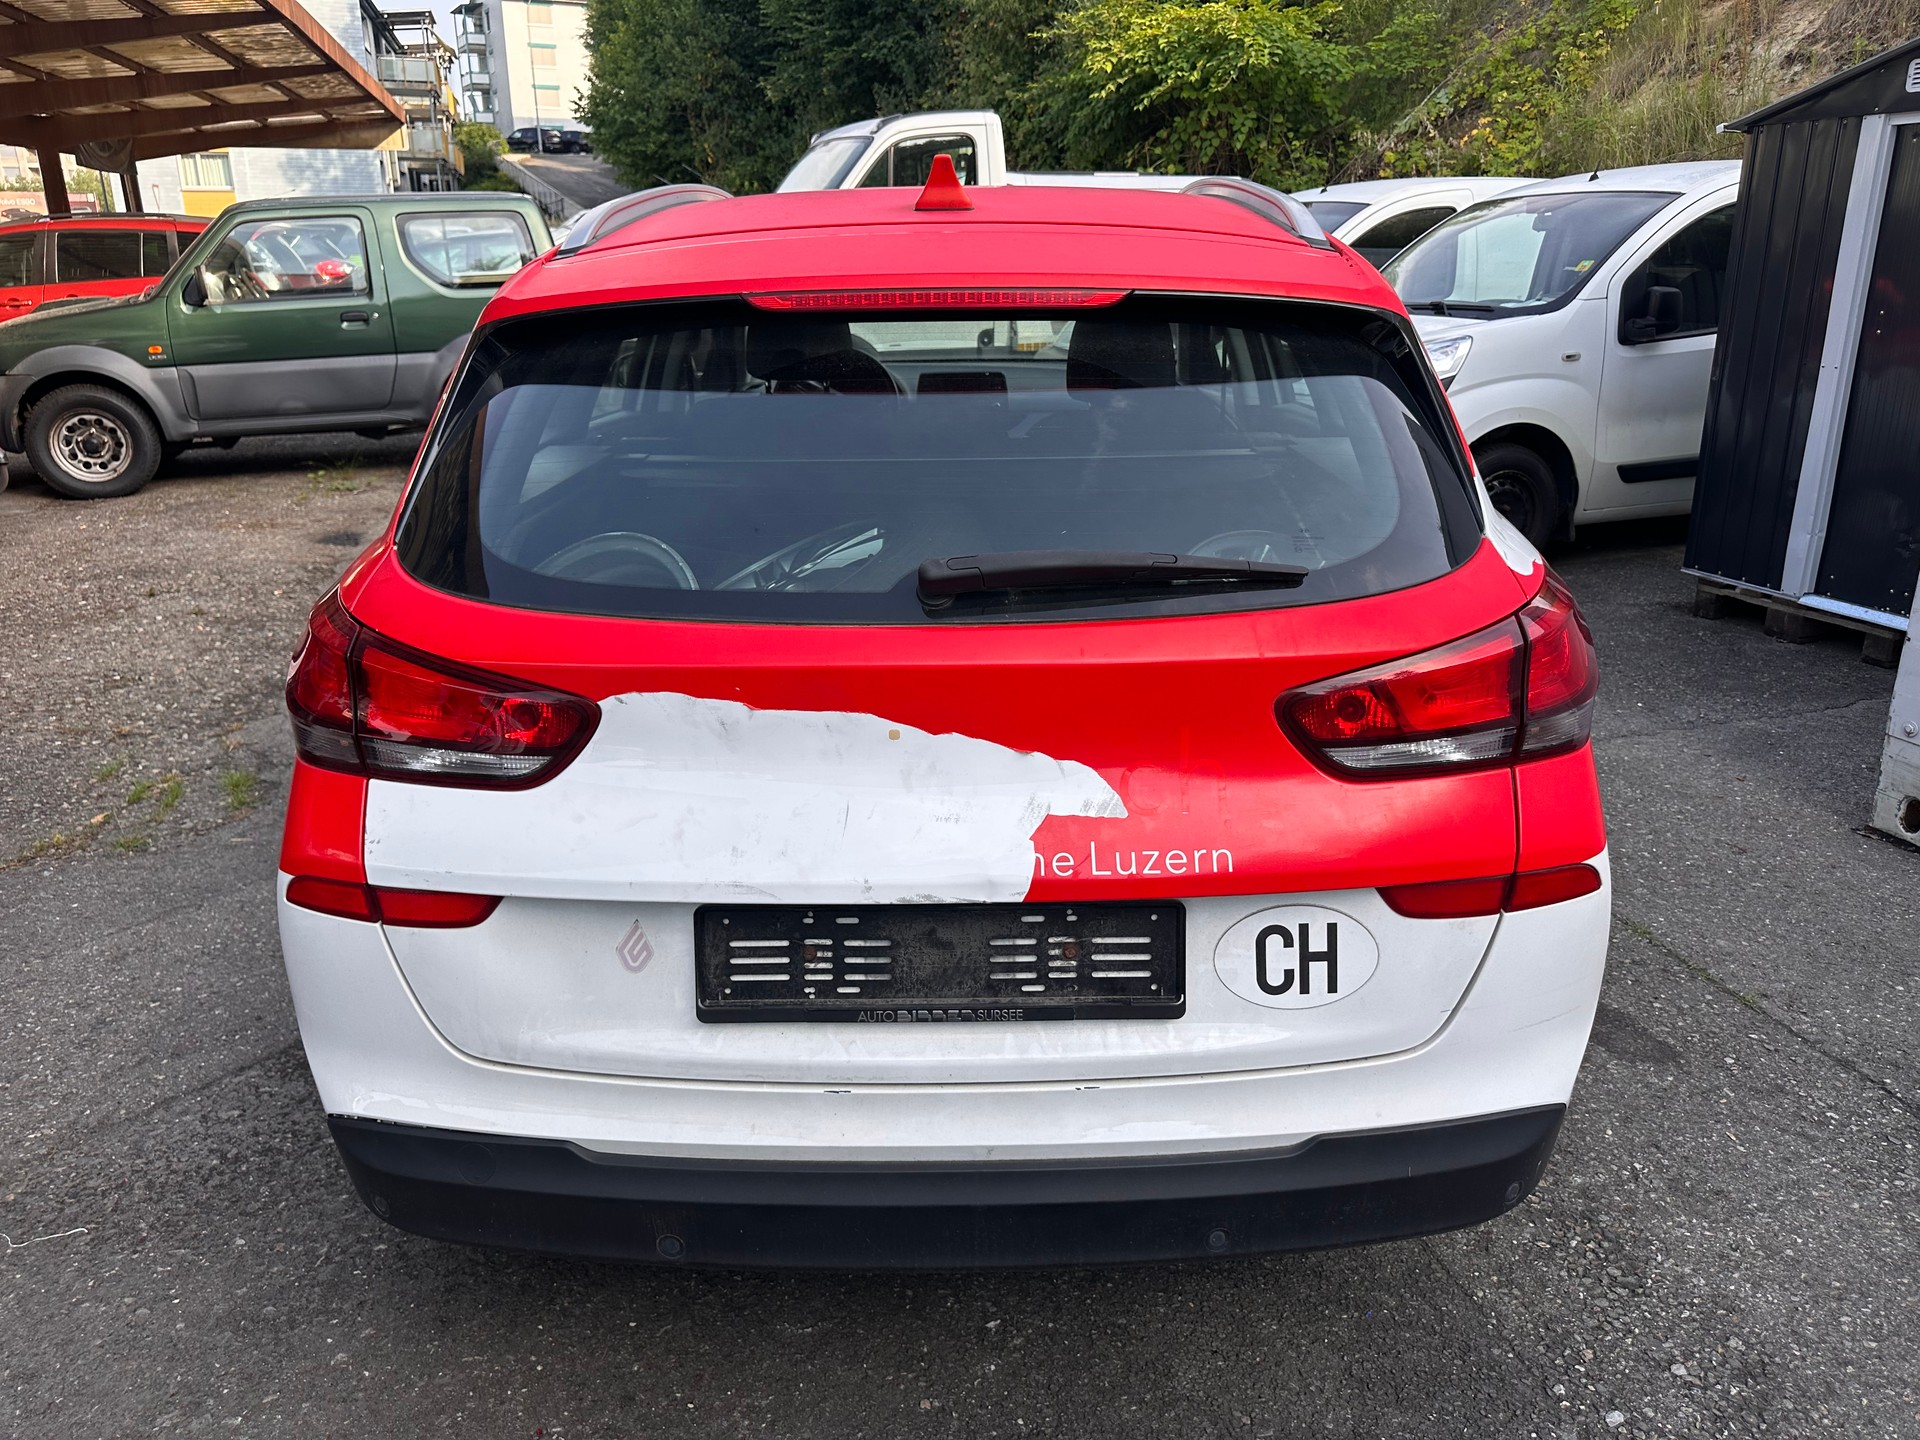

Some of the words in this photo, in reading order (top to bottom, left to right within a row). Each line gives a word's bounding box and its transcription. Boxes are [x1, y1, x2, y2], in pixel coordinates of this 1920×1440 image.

[1090, 841, 1234, 876] Luzern
[1255, 922, 1338, 996] CH
[857, 1010, 895, 1022] AUTO
[977, 1009, 1024, 1021] SURSEE
